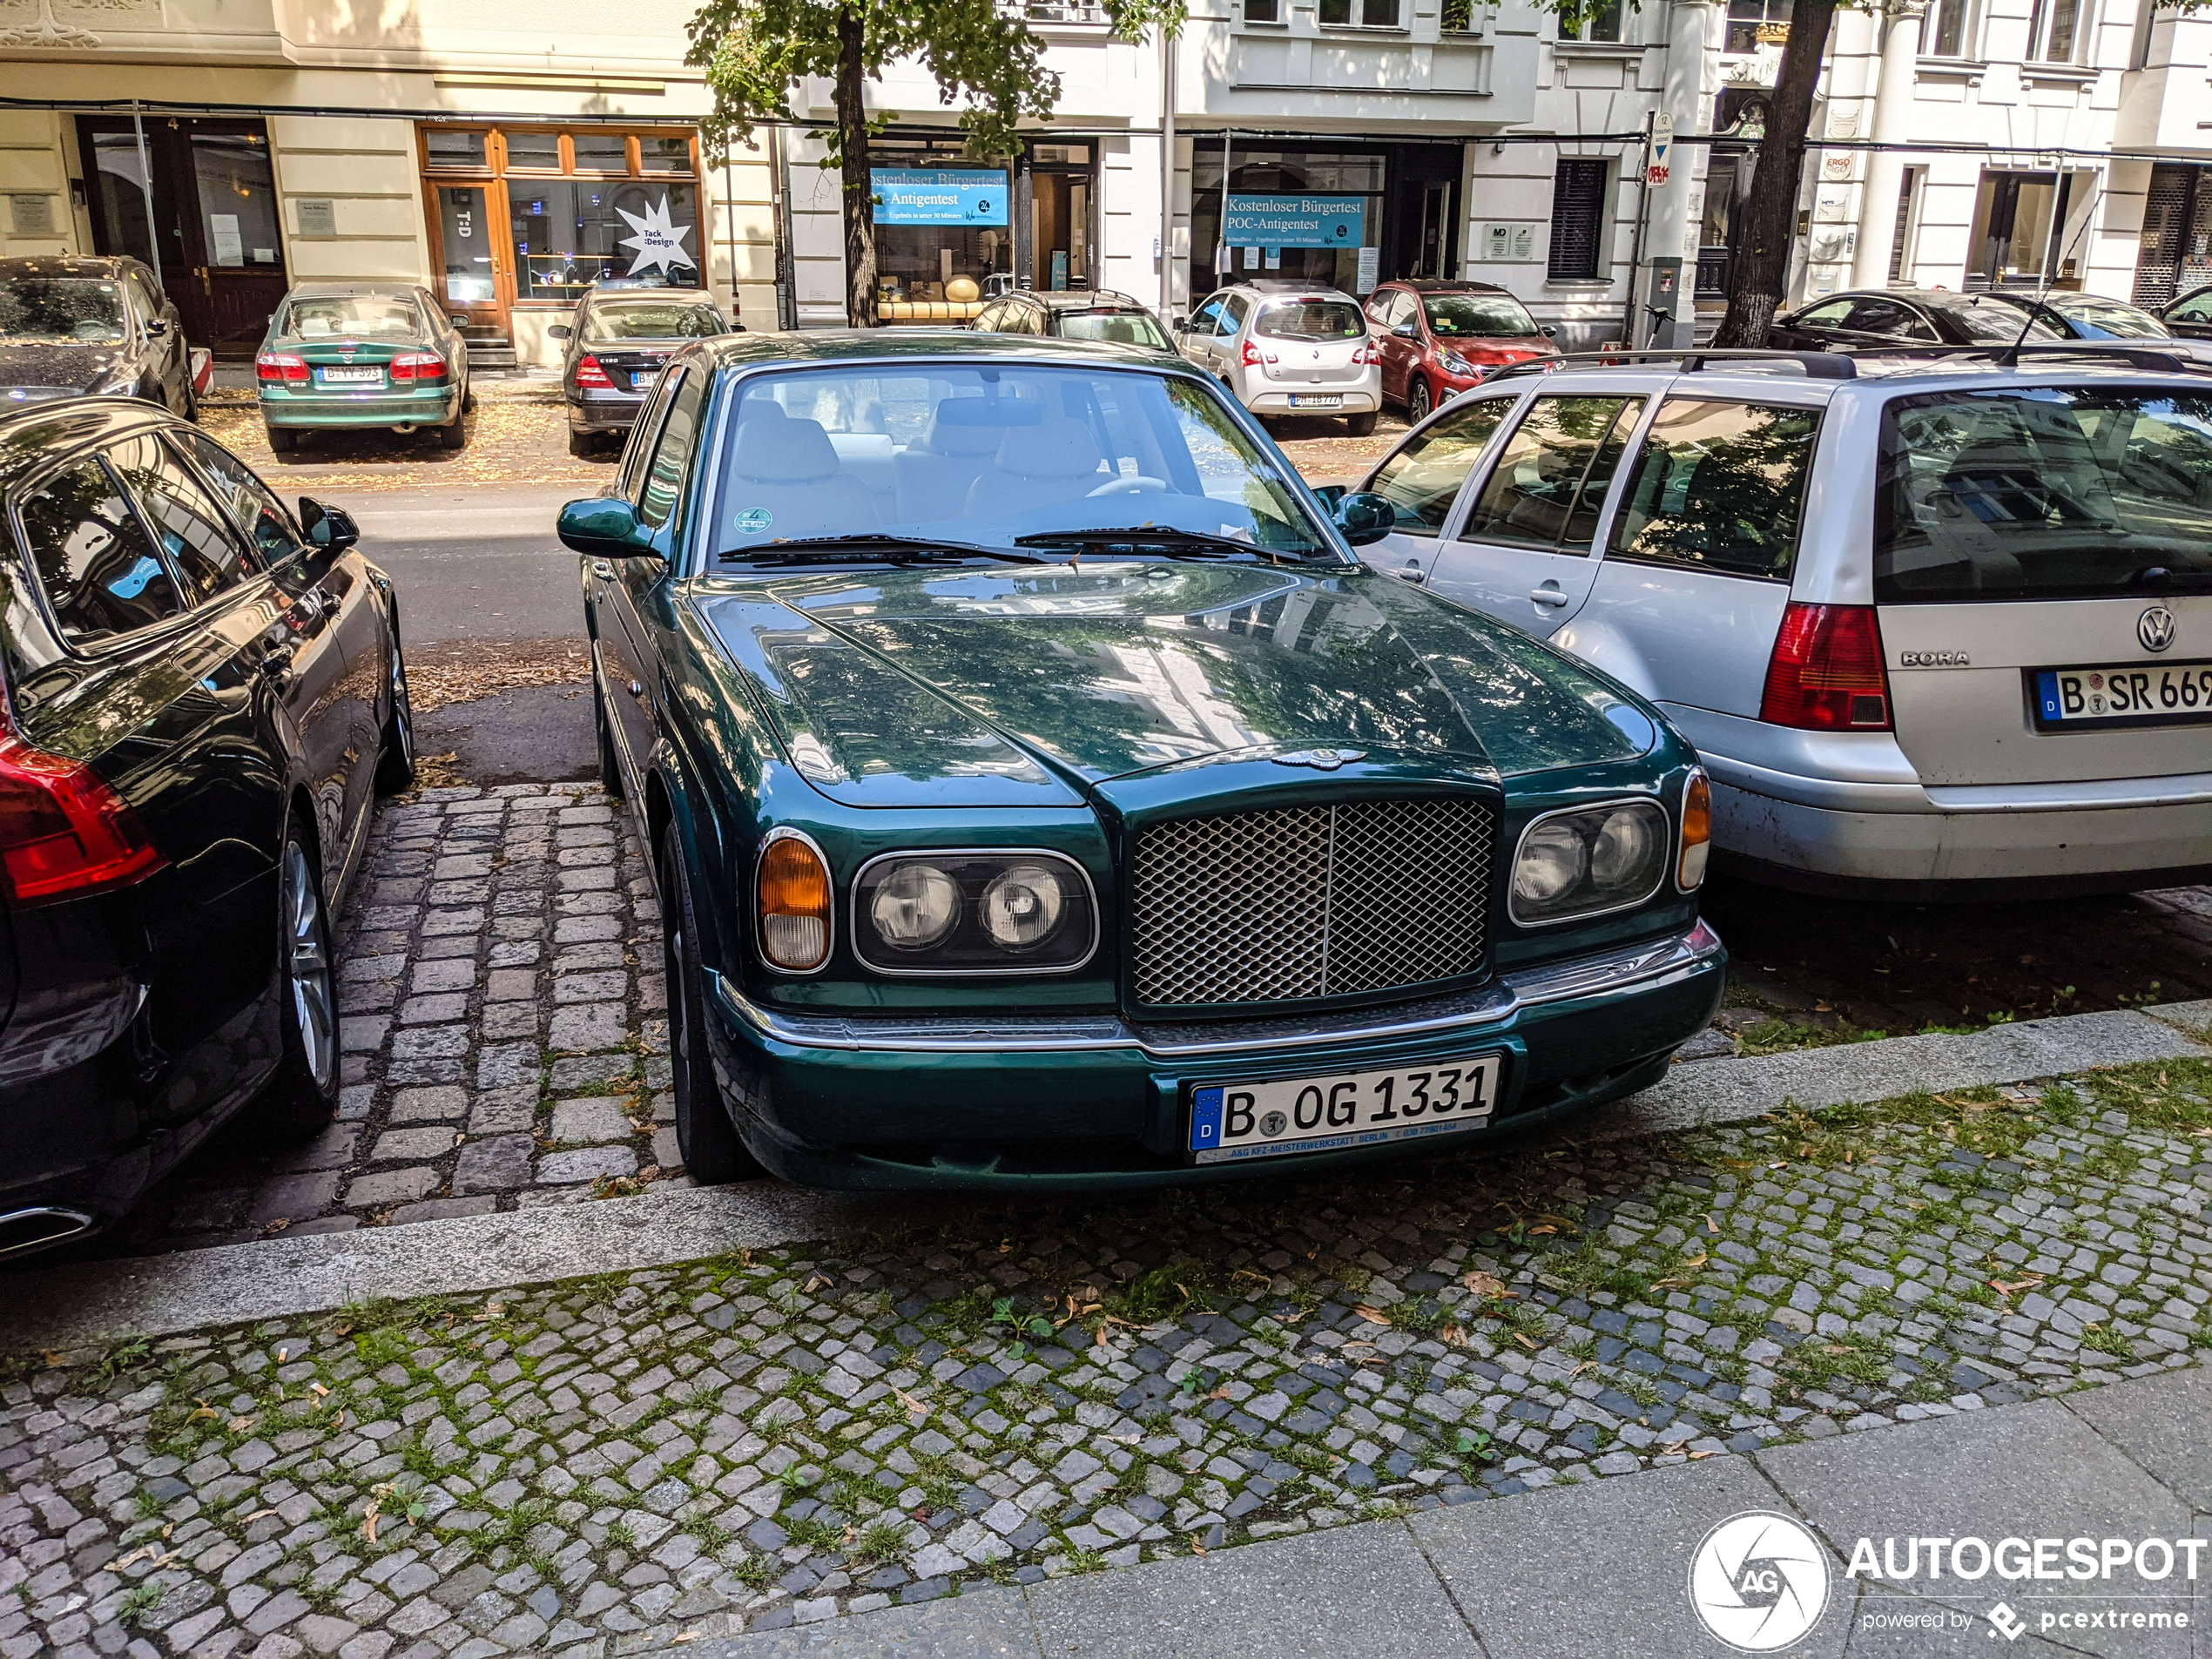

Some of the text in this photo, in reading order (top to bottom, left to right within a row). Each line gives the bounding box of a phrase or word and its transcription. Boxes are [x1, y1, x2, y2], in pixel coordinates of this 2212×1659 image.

[168, 117, 179, 130] 4
[1661, 116, 1668, 125] 12
[870, 172, 1004, 191] ostenloser Bürgertest
[1228, 199, 1361, 216] Kostenloser Bürgertest
[456, 211, 472, 238] T:D
[1227, 217, 1318, 233] POC-Antigentest
[644, 229, 662, 238] Tack
[1494, 227, 1507, 237] MD
[644, 238, 675, 248] :Design
[327, 367, 379, 378] B YY 393
[638, 373, 646, 383] B
[1296, 395, 1307, 404] PM
[1324, 395, 1339, 404] 777
[749, 509, 759, 520] 4
[1901, 651, 1970, 666] BORA
[2047, 671, 2212, 714] D B SR 669
[1200, 1065, 1487, 1138] D B OG 1331
[1231, 1149, 1250, 1158] A&G
[1251, 1136, 1355, 1156] KFZ-MEISTERWERKSTATT
[1359, 1132, 1388, 1143] BERLIN
